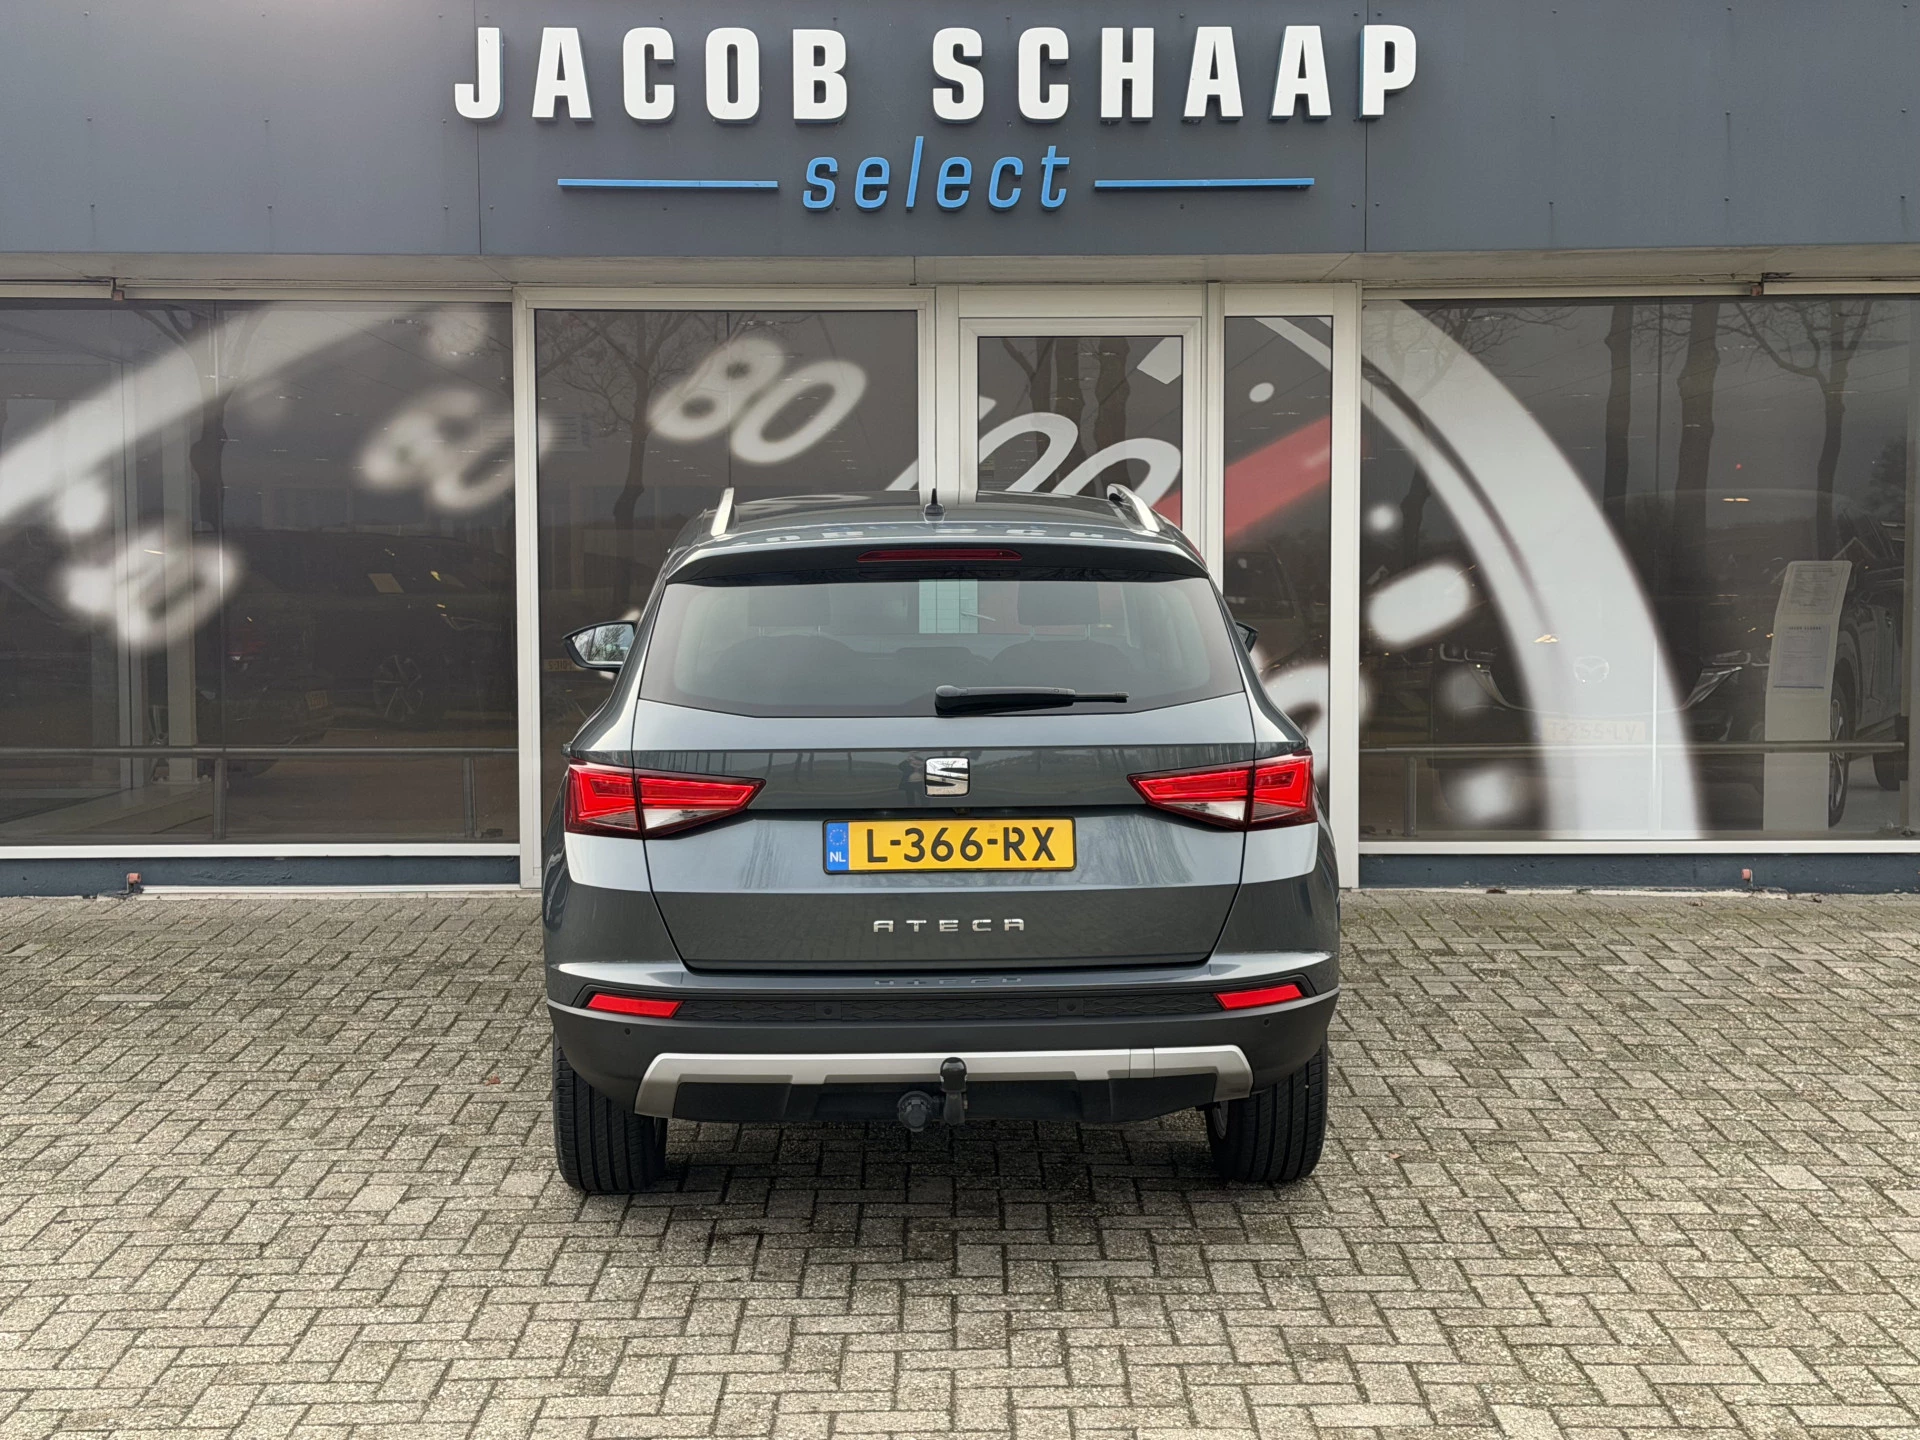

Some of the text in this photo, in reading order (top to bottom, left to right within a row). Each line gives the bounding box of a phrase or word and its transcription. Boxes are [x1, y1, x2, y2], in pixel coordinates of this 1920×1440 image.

[455, 25, 1417, 121] JACOB SCHAAP
[803, 136, 1070, 210] select
[648, 336, 867, 465] 80
[829, 826, 1056, 863] NL L-366-RX
[873, 918, 1025, 933] ATECA
